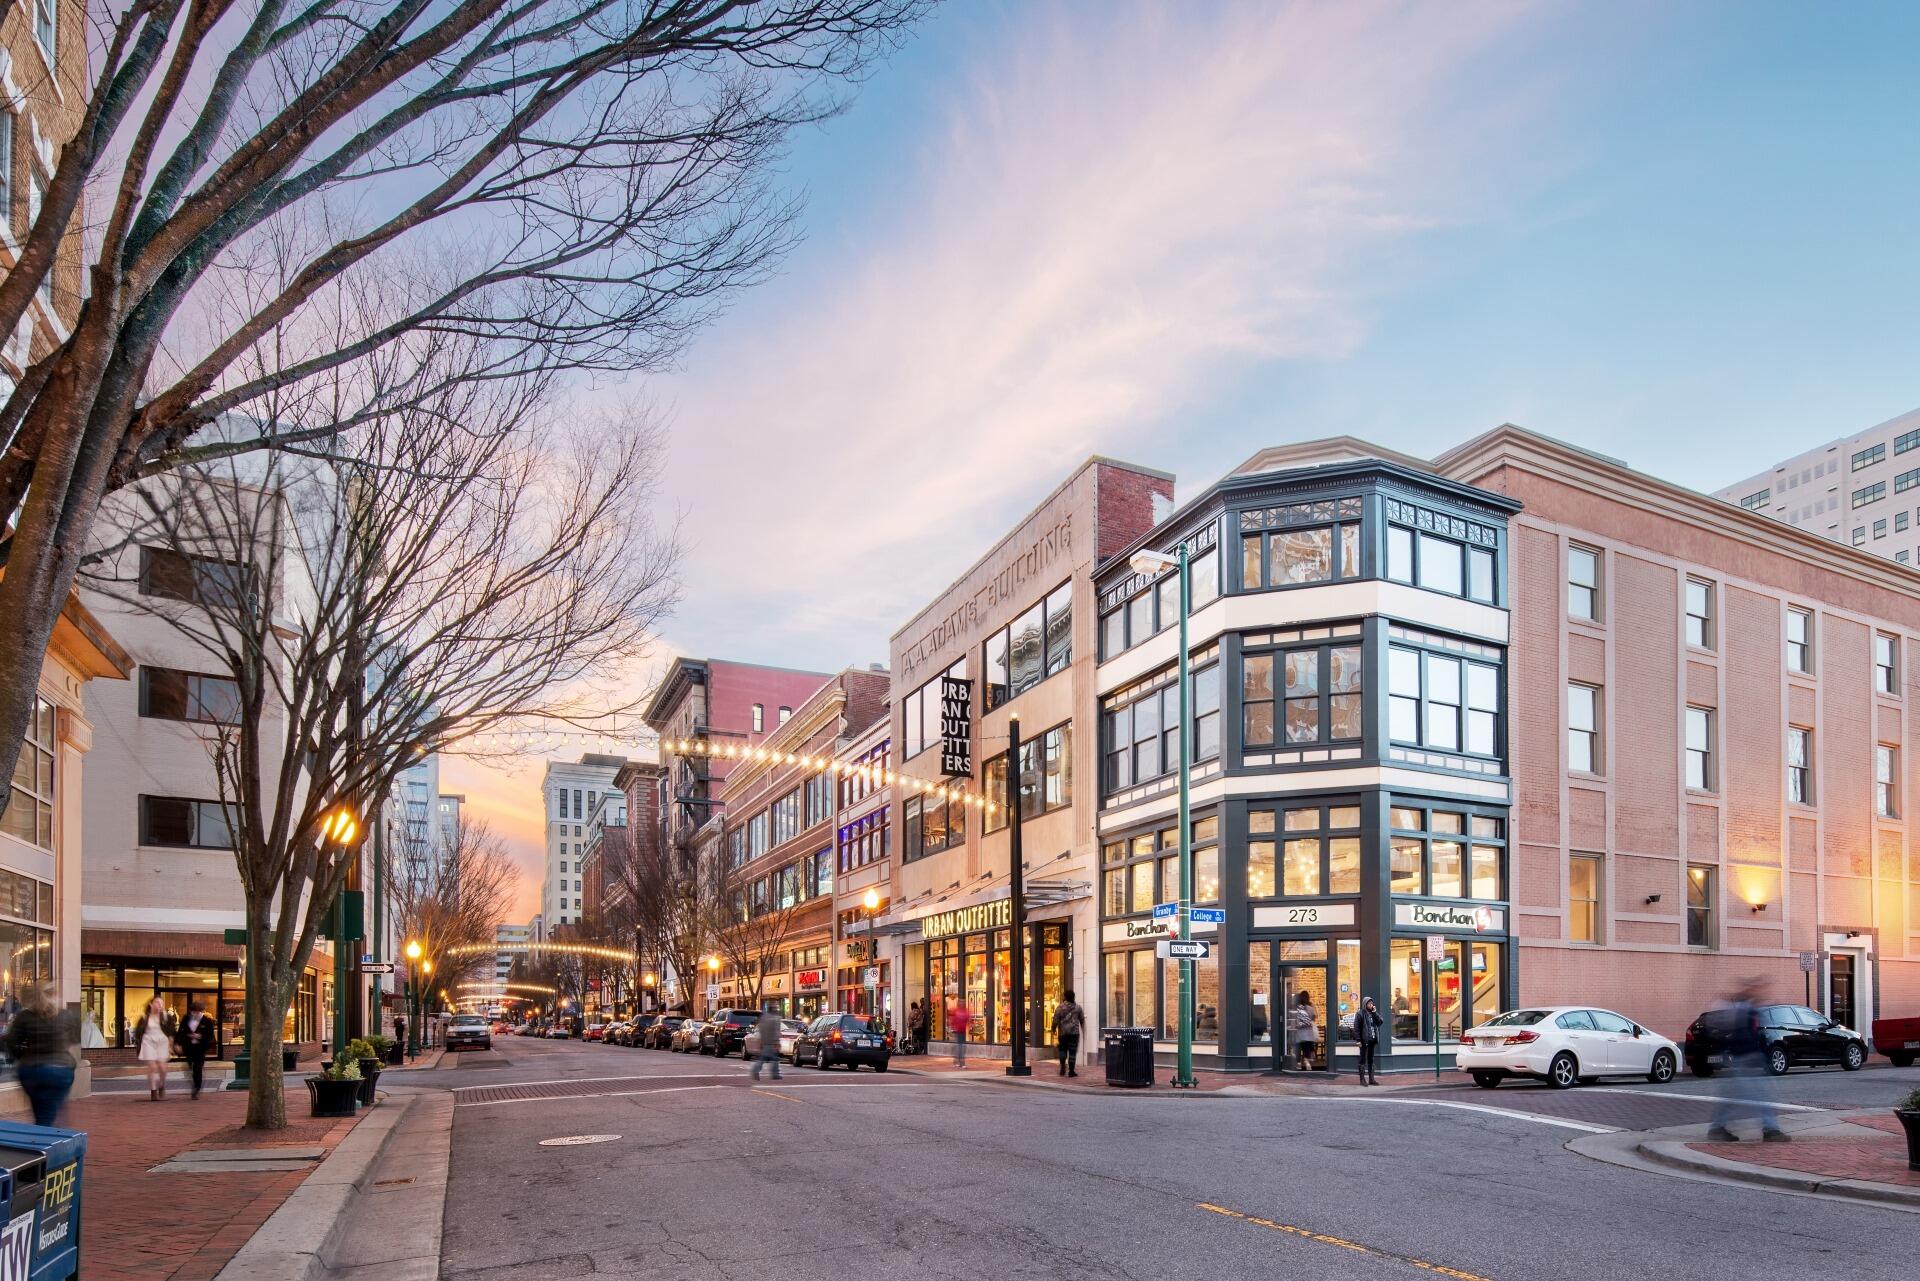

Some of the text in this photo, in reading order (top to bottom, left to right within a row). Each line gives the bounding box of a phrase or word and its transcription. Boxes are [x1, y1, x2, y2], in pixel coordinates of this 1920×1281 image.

[988, 514, 1073, 607] BUILDING
[942, 682, 970, 701] URB
[942, 754, 970, 772] ERS
[922, 900, 1012, 938] URBAN OUTFITTE
[1156, 905, 1171, 917] Granby
[1194, 910, 1212, 922] College
[1289, 908, 1317, 922] 273
[42, 1162, 77, 1212] FREE
